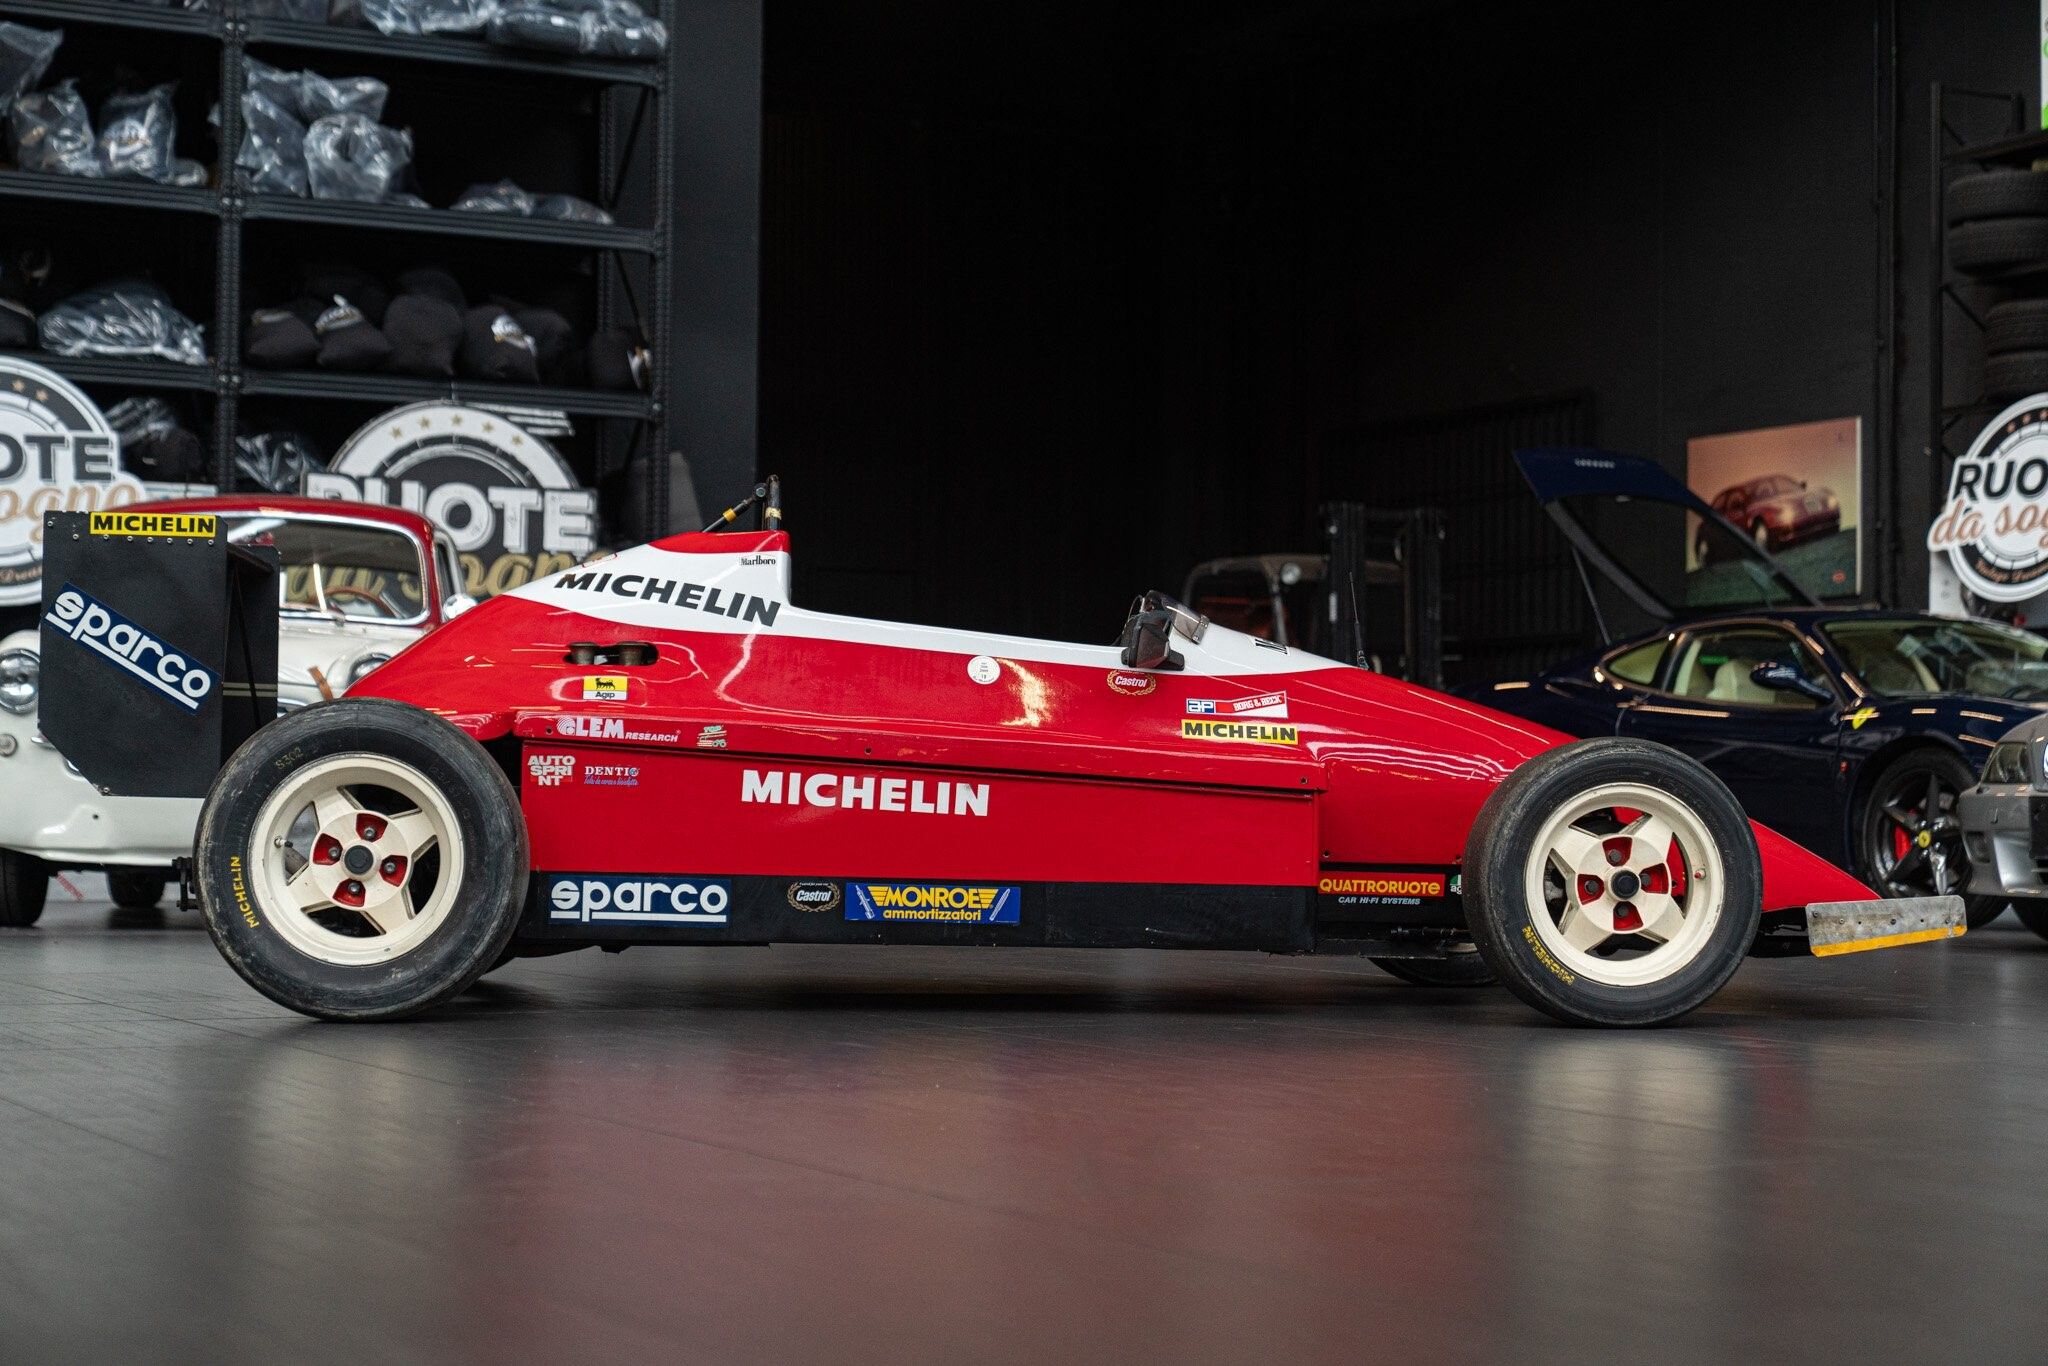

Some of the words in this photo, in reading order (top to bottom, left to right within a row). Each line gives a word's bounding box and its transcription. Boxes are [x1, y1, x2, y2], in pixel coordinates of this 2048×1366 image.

[93, 514, 216, 534] MICHELIN
[740, 555, 777, 566] Marlboro
[554, 572, 781, 627] MICHELIN
[54, 591, 212, 698] sparco
[1114, 675, 1148, 688] Castrol
[595, 690, 616, 700] Agip
[625, 731, 679, 743] RESEARCH
[1184, 722, 1296, 741] MICHELIN
[527, 755, 576, 766] AUTO
[530, 765, 573, 776] SPRI
[538, 775, 564, 786] NT
[741, 769, 990, 817] MICHELIN
[231, 855, 260, 929] MICHELIN
[796, 890, 832, 902] Castrol
[884, 886, 982, 909] MONROE
[551, 880, 728, 922] sparco
[1338, 896, 1357, 904] CAR
[1381, 897, 1421, 906] SYSTEMS
[883, 908, 982, 921] ammortizzatori
[1522, 926, 1575, 986] MICHELIN
